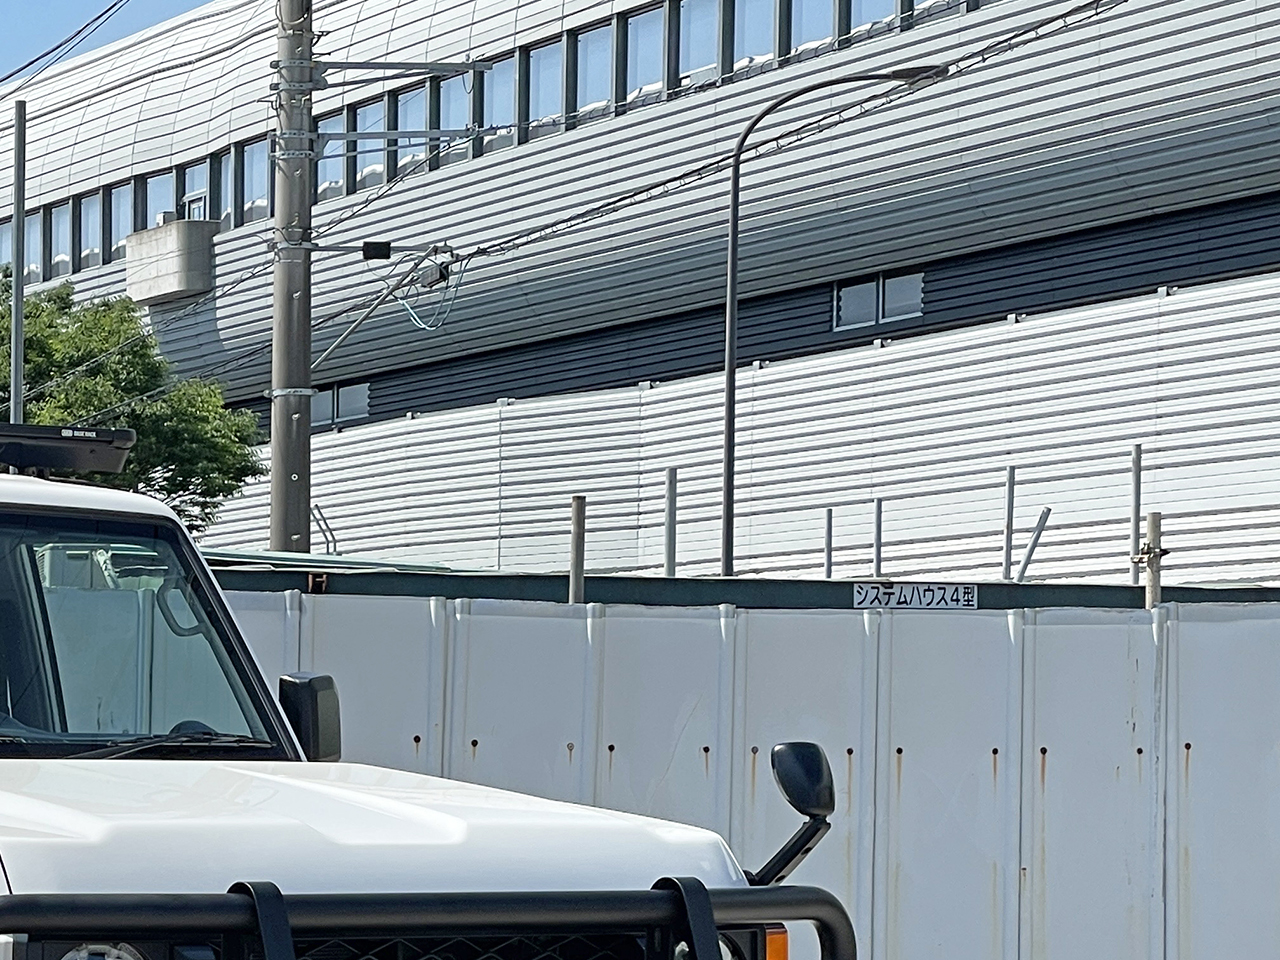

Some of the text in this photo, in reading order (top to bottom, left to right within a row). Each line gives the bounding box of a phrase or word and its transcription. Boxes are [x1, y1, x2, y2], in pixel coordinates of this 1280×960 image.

[856, 585, 975, 607] システムハウス4型
